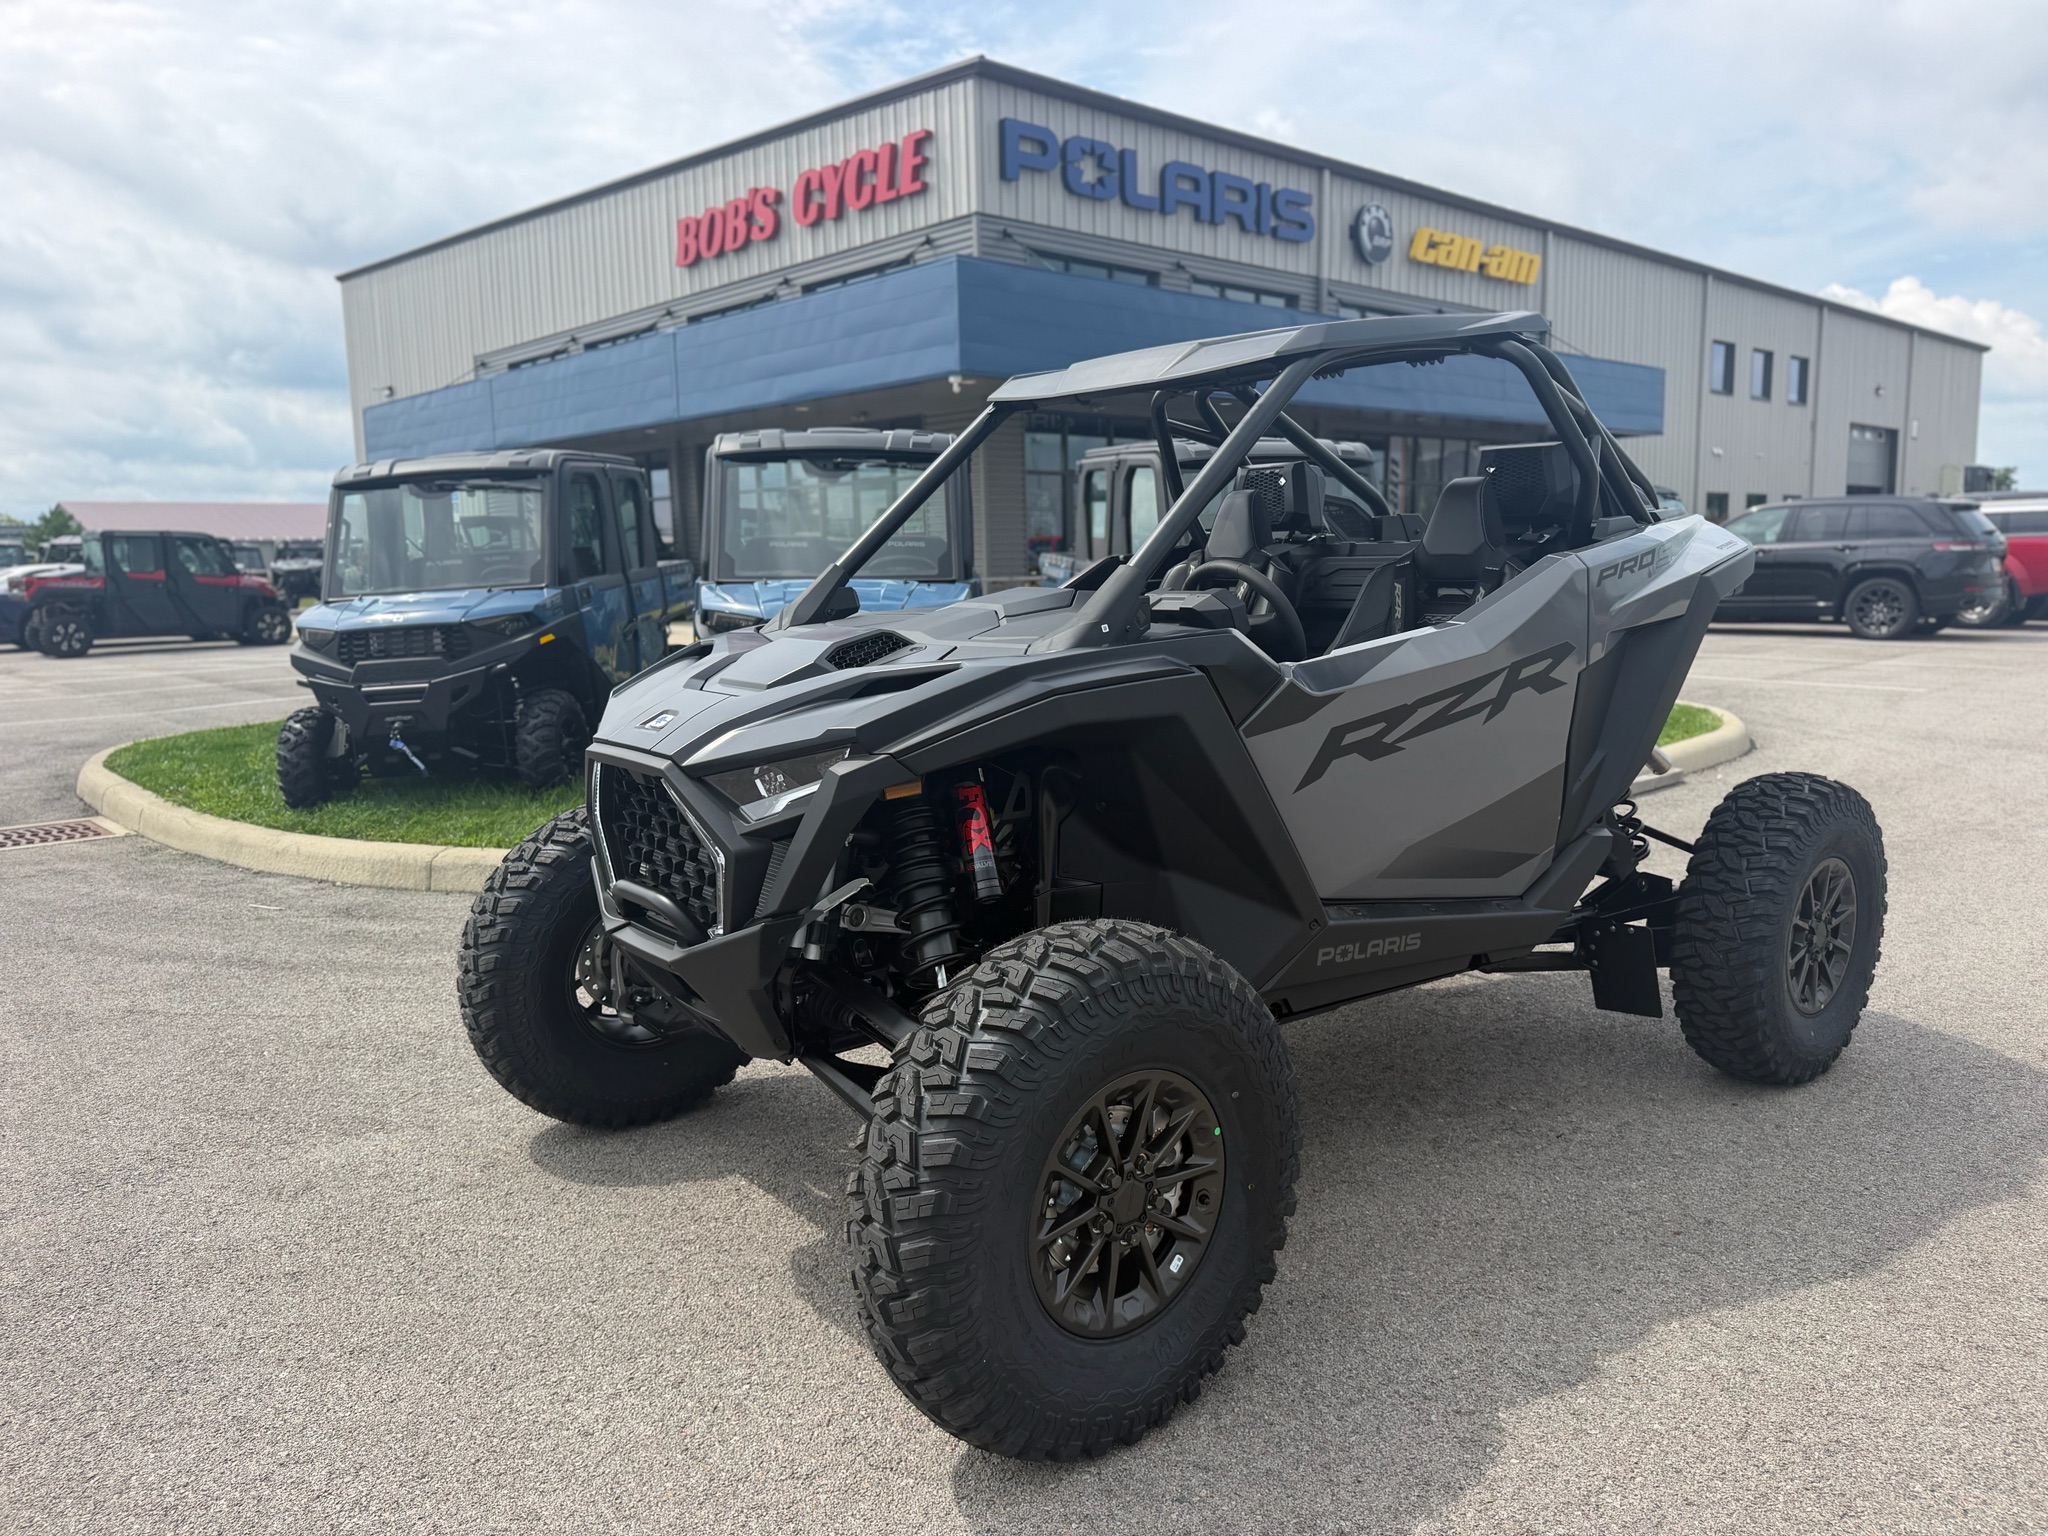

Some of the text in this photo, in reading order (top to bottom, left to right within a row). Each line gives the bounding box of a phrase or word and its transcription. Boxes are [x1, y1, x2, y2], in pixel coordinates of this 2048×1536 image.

[676, 129, 933, 267] BOB'S CYCLE
[1000, 117, 1315, 243] POLARIS
[1394, 583, 1402, 619] RZR
[1596, 548, 1656, 588] PRO
[1293, 641, 1576, 794] RZR
[957, 785, 993, 855] FOX
[1317, 932, 1421, 966] POLARIS
